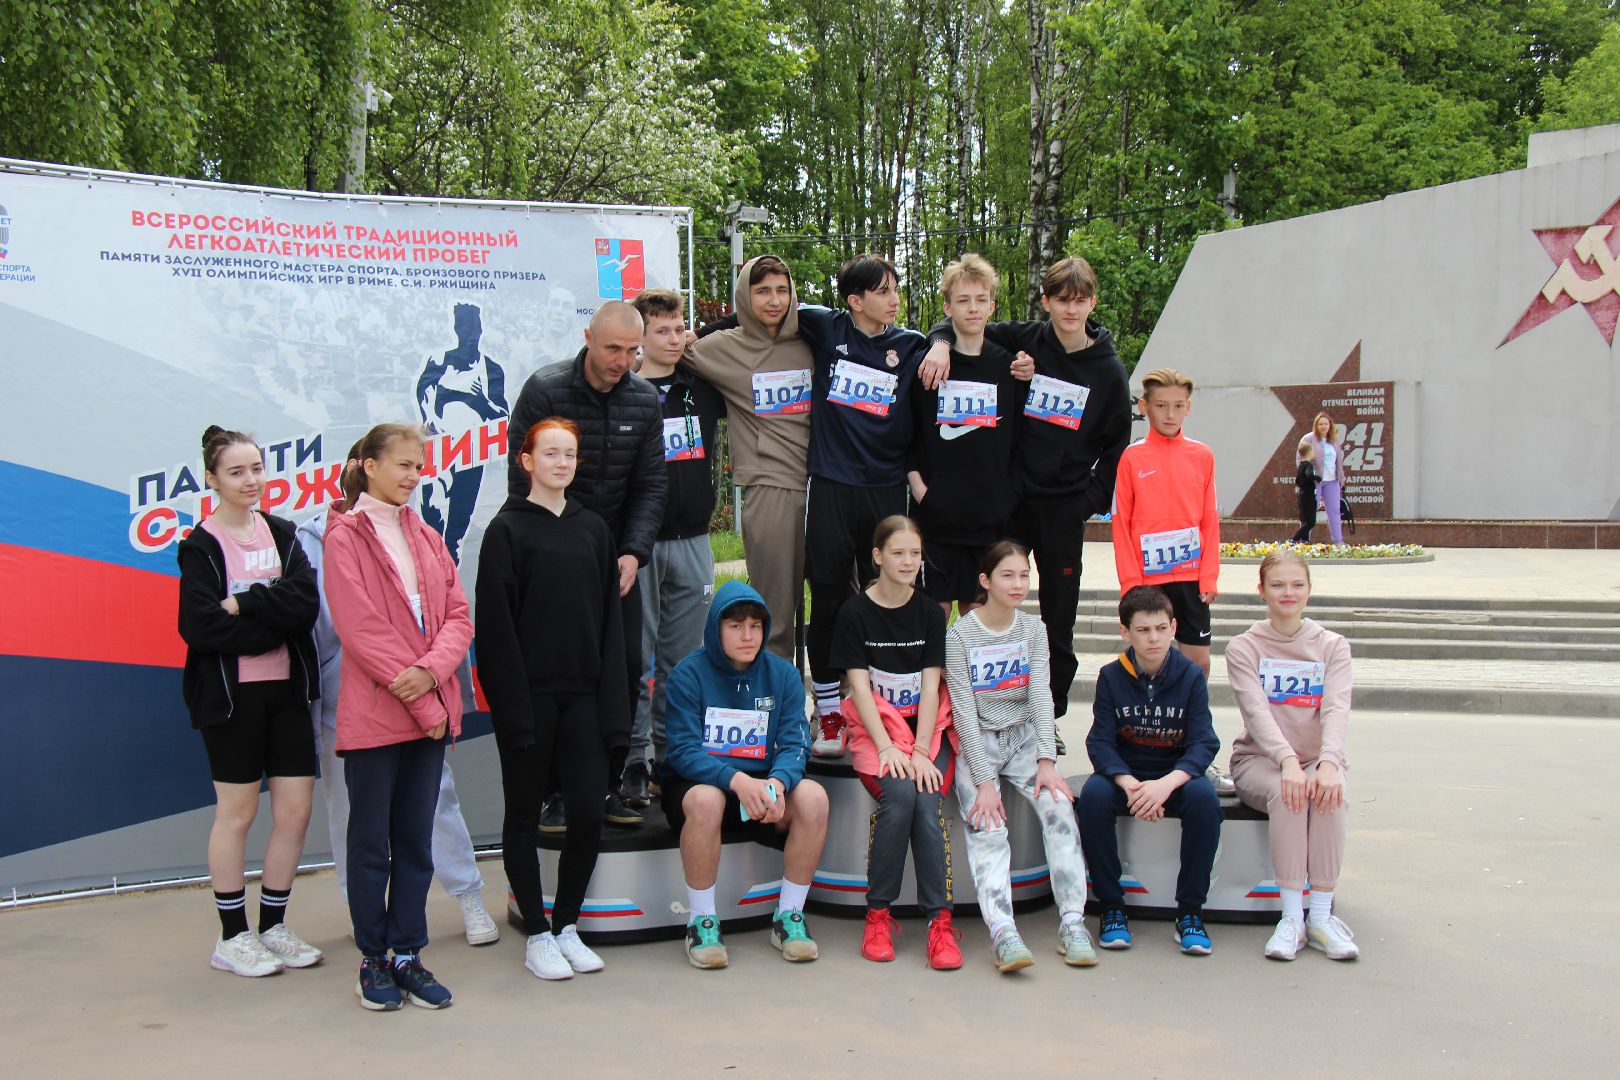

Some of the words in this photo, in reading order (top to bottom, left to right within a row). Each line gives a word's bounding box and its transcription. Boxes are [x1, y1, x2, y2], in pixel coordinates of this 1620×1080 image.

[131, 210, 338, 241] ВСЕРОССИЙСКИЙ
[343, 225, 519, 248] ТРАДИЦИОННЫЙ
[168, 233, 407, 262] ЛЕГКОАТЛЕТИЧЕСКИЙ
[412, 248, 491, 265] ПРОБЕГ
[99, 251, 161, 265] ПАМЯТИ
[164, 255, 280, 271] ЗАСЛУЖЕННОГО
[283, 262, 344, 275] МАСТЕРА
[405, 268, 491, 281] БРОНЗОВОГО
[493, 272, 547, 284] ПРИЗЕРА
[207, 268, 315, 285] ОЛИМПИЙСКИХ
[318, 276, 344, 286] ИГР
[347, 277, 356, 286] В
[400, 279, 427, 290] С.И.
[429, 279, 497, 292] РЖИЩИНА
[765, 385, 804, 405] 107
[841, 377, 885, 404] 105
[1347, 388, 1385, 397] ВЕЛИКАЯ
[953, 396, 987, 416] 111
[1039, 391, 1075, 417] 112
[1321, 398, 1385, 407] ОТЕЧЕСТВЕННАЯ
[1356, 406, 1385, 415] ВОЙНА
[138, 434, 322, 507] ПАТИ
[1155, 543, 1193, 566] 113
[983, 659, 1022, 681] 274
[877, 682, 914, 707] 118
[1272, 675, 1312, 695] 121
[713, 725, 760, 746] 106
